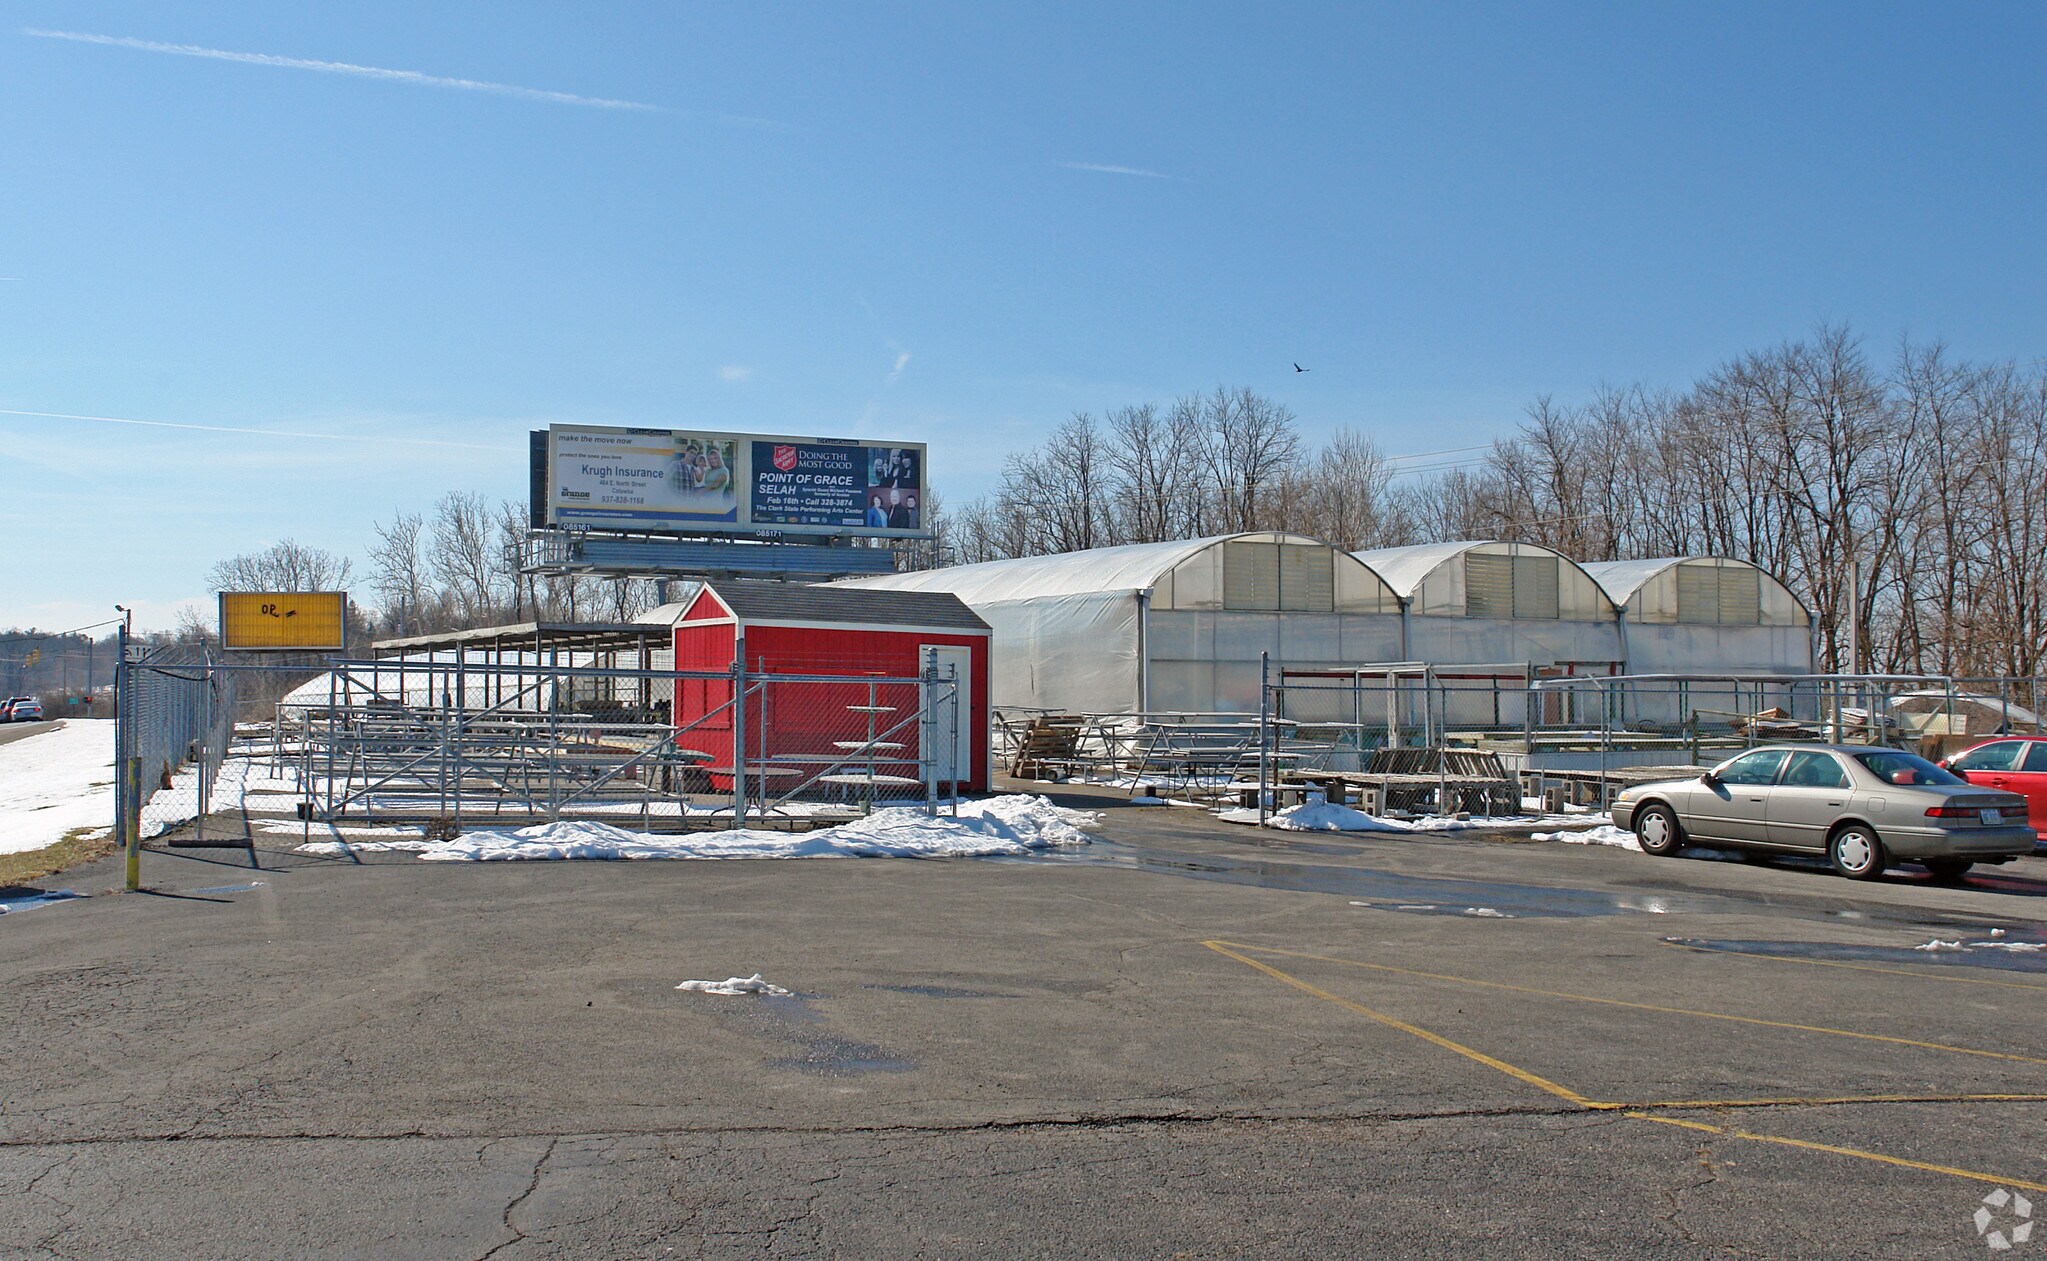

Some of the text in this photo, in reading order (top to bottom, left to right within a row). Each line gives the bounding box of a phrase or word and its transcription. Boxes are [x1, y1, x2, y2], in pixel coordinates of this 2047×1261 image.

[799, 450, 848, 461] DOING THE
[798, 460, 853, 470] MOST GOOD
[582, 464, 664, 479] Krugh Insurance
[759, 472, 854, 486] POINT OF GRACE
[759, 484, 797, 495] SELAH
[767, 496, 781, 504] Feb
[783, 497, 799, 505] 16th
[805, 498, 820, 506] Call
[800, 506, 831, 515] Performing
[563, 523, 591, 531] 085161
